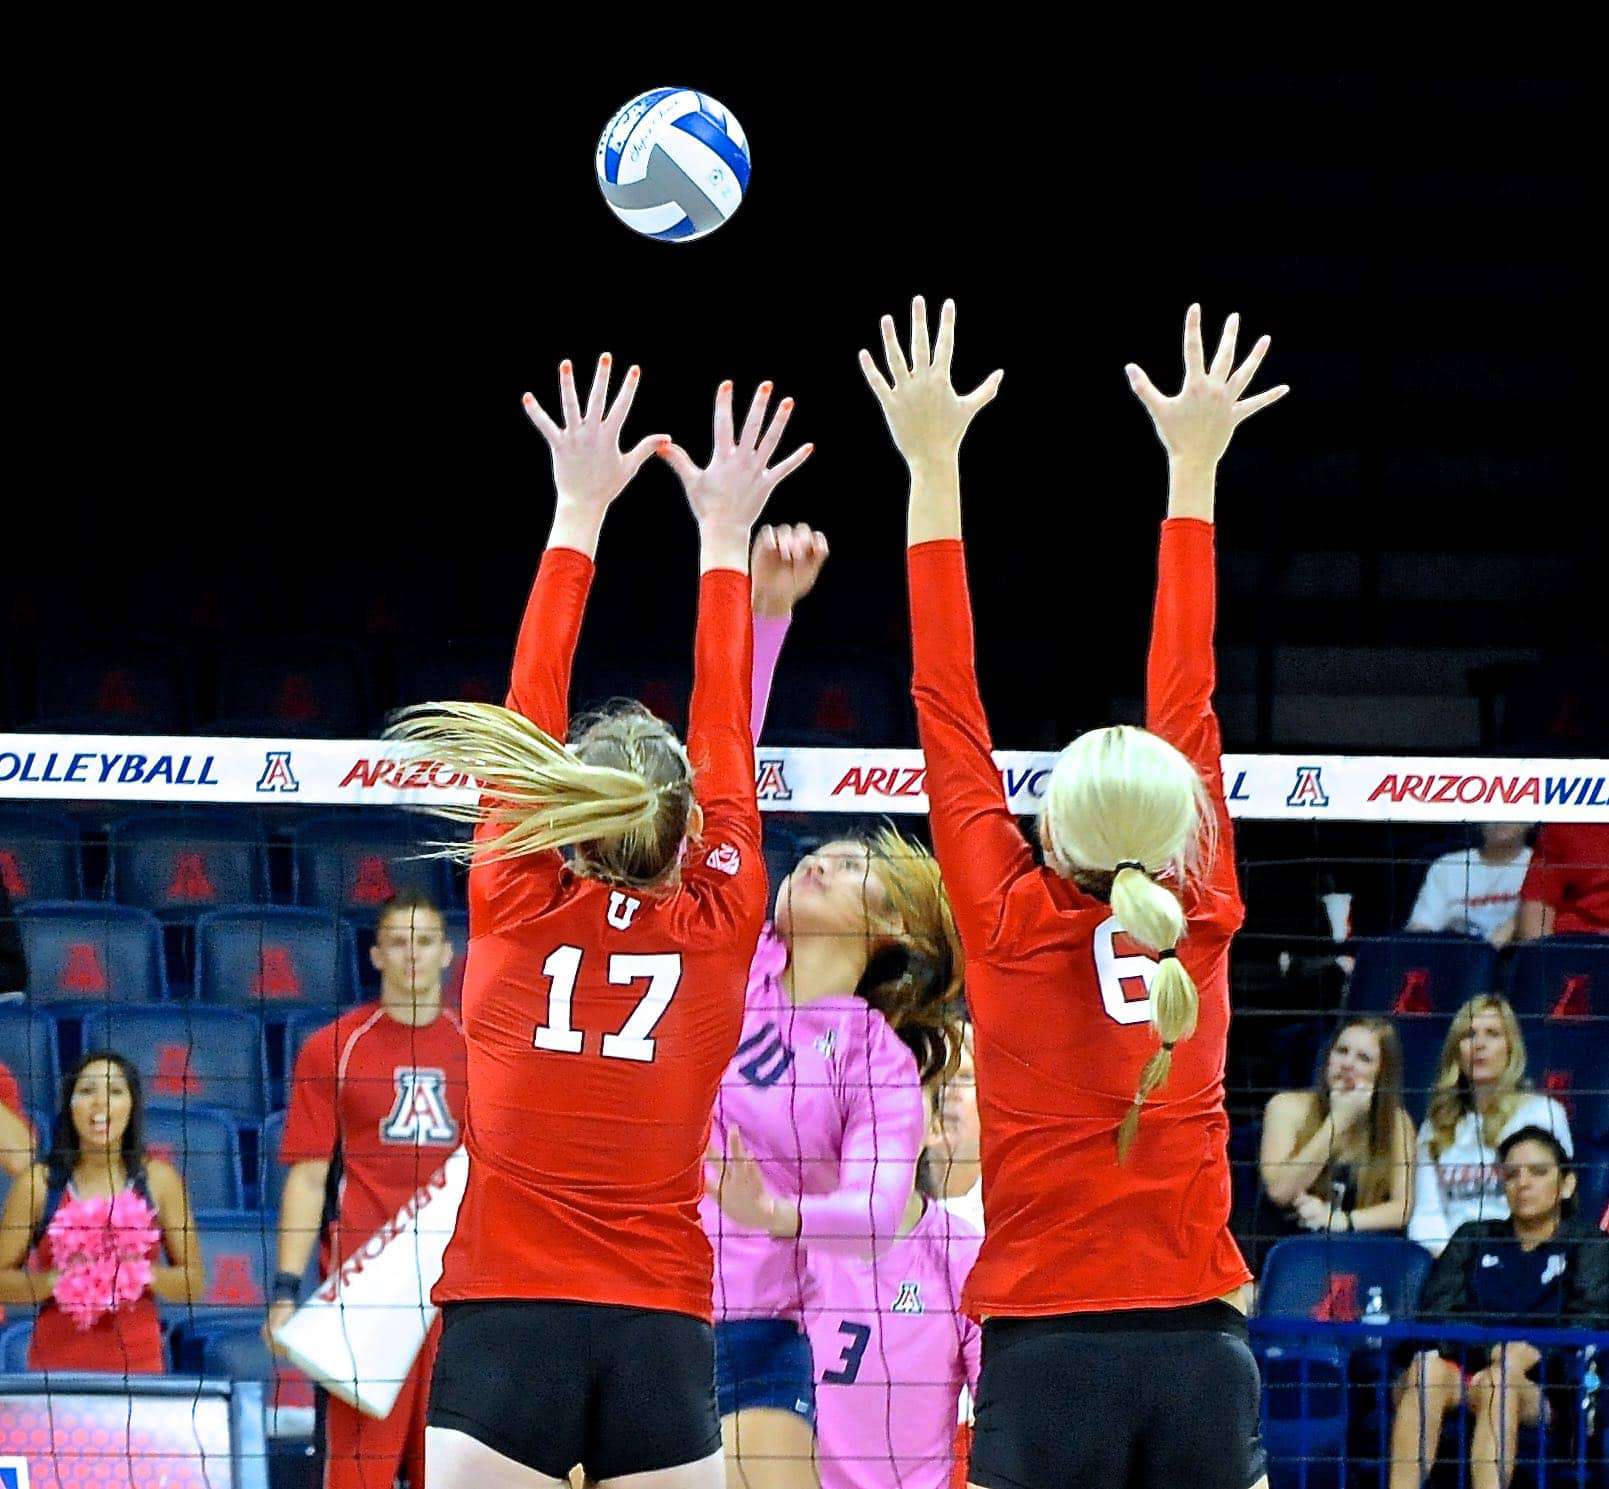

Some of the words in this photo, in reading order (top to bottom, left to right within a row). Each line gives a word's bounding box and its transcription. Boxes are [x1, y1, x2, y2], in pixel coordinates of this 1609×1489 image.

[0, 752, 218, 785] OLLEYBALL
[256, 752, 299, 792] A
[757, 760, 793, 799] A
[831, 768, 925, 796] ARIZ
[1287, 766, 1329, 806] A
[1367, 775, 1609, 806] ARIZONAWIL
[606, 890, 640, 931] U
[1094, 915, 1158, 1025] 6
[534, 944, 682, 1062] 17
[379, 1067, 459, 1145] A
[892, 1282, 923, 1312] A
[822, 1320, 871, 1385] 3
